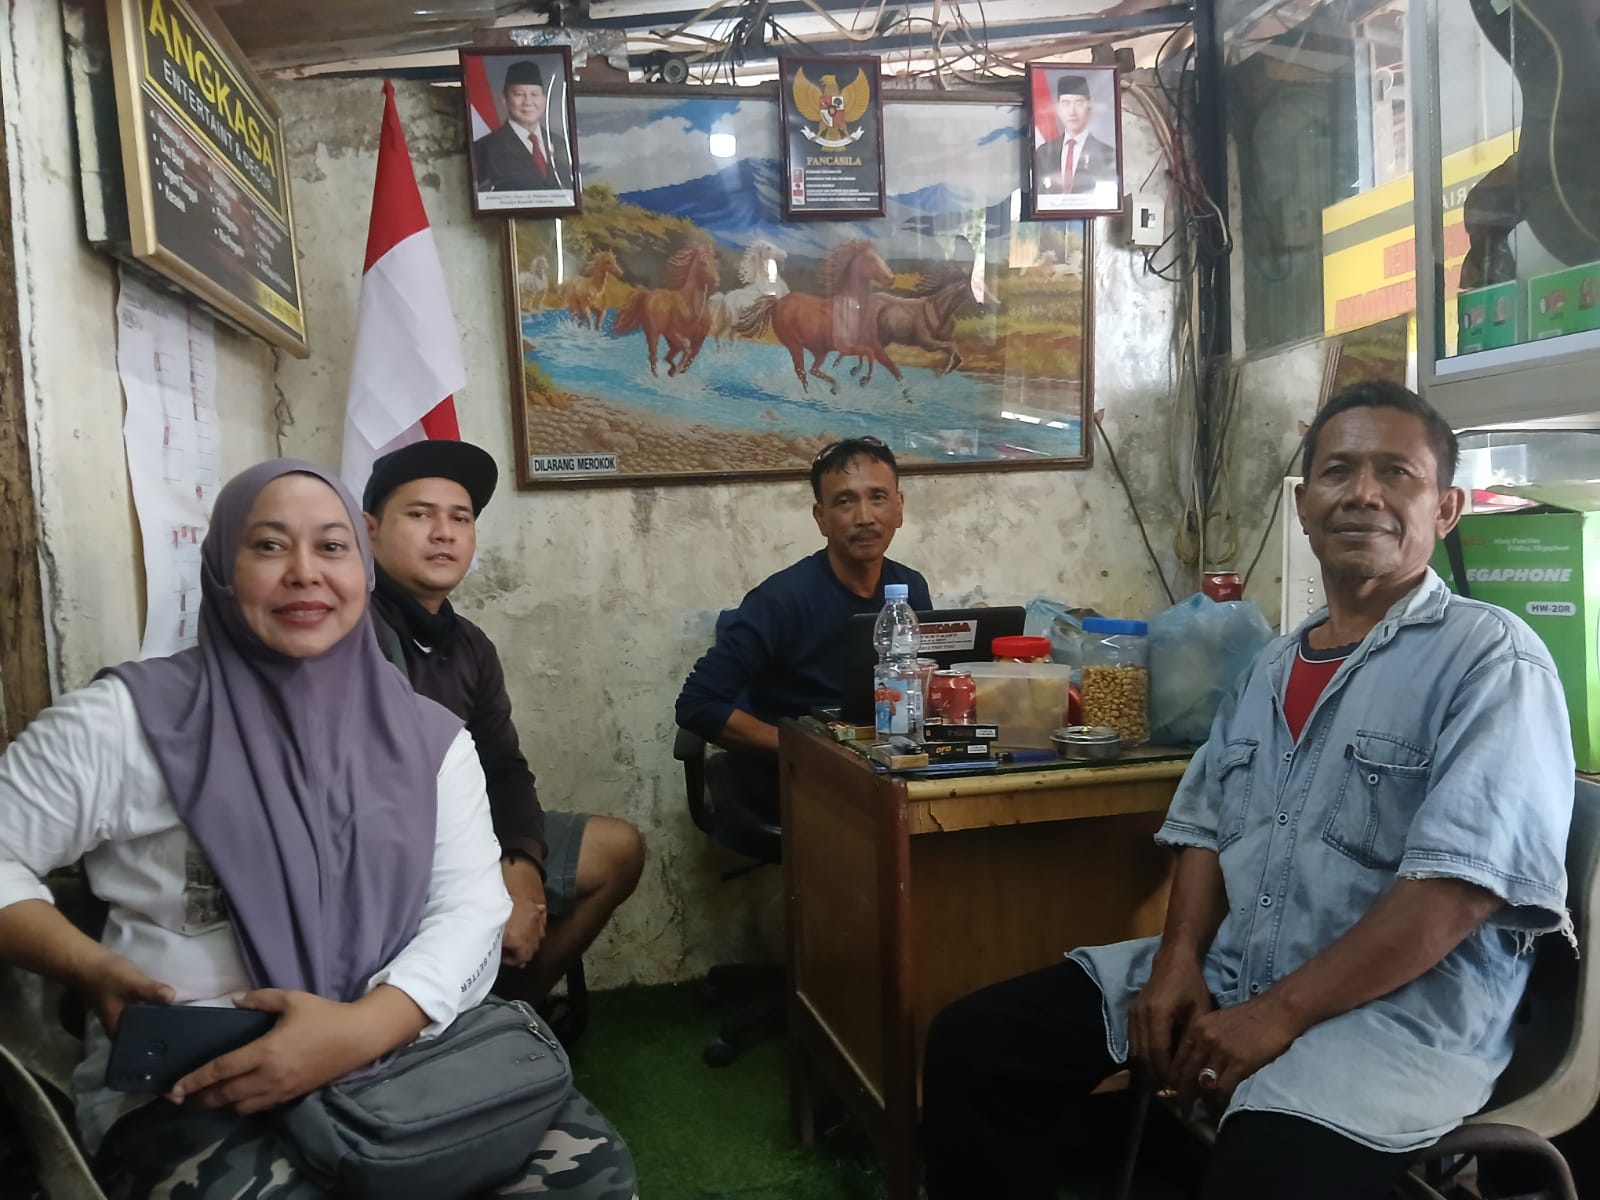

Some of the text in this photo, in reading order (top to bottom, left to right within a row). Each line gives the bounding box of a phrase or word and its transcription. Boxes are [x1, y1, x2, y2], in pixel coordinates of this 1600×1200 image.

[148, 0, 277, 178] ANGKASA
[162, 58, 233, 151] ENTERTAINT
[234, 144, 243, 163] &
[243, 154, 273, 196] DECOR
[806, 155, 862, 166] PANCASILA
[534, 456, 616, 472] DILARANG MEROKOK
[1451, 567, 1573, 582] EGAPHONE
[1531, 603, 1571, 614] HW-20R
